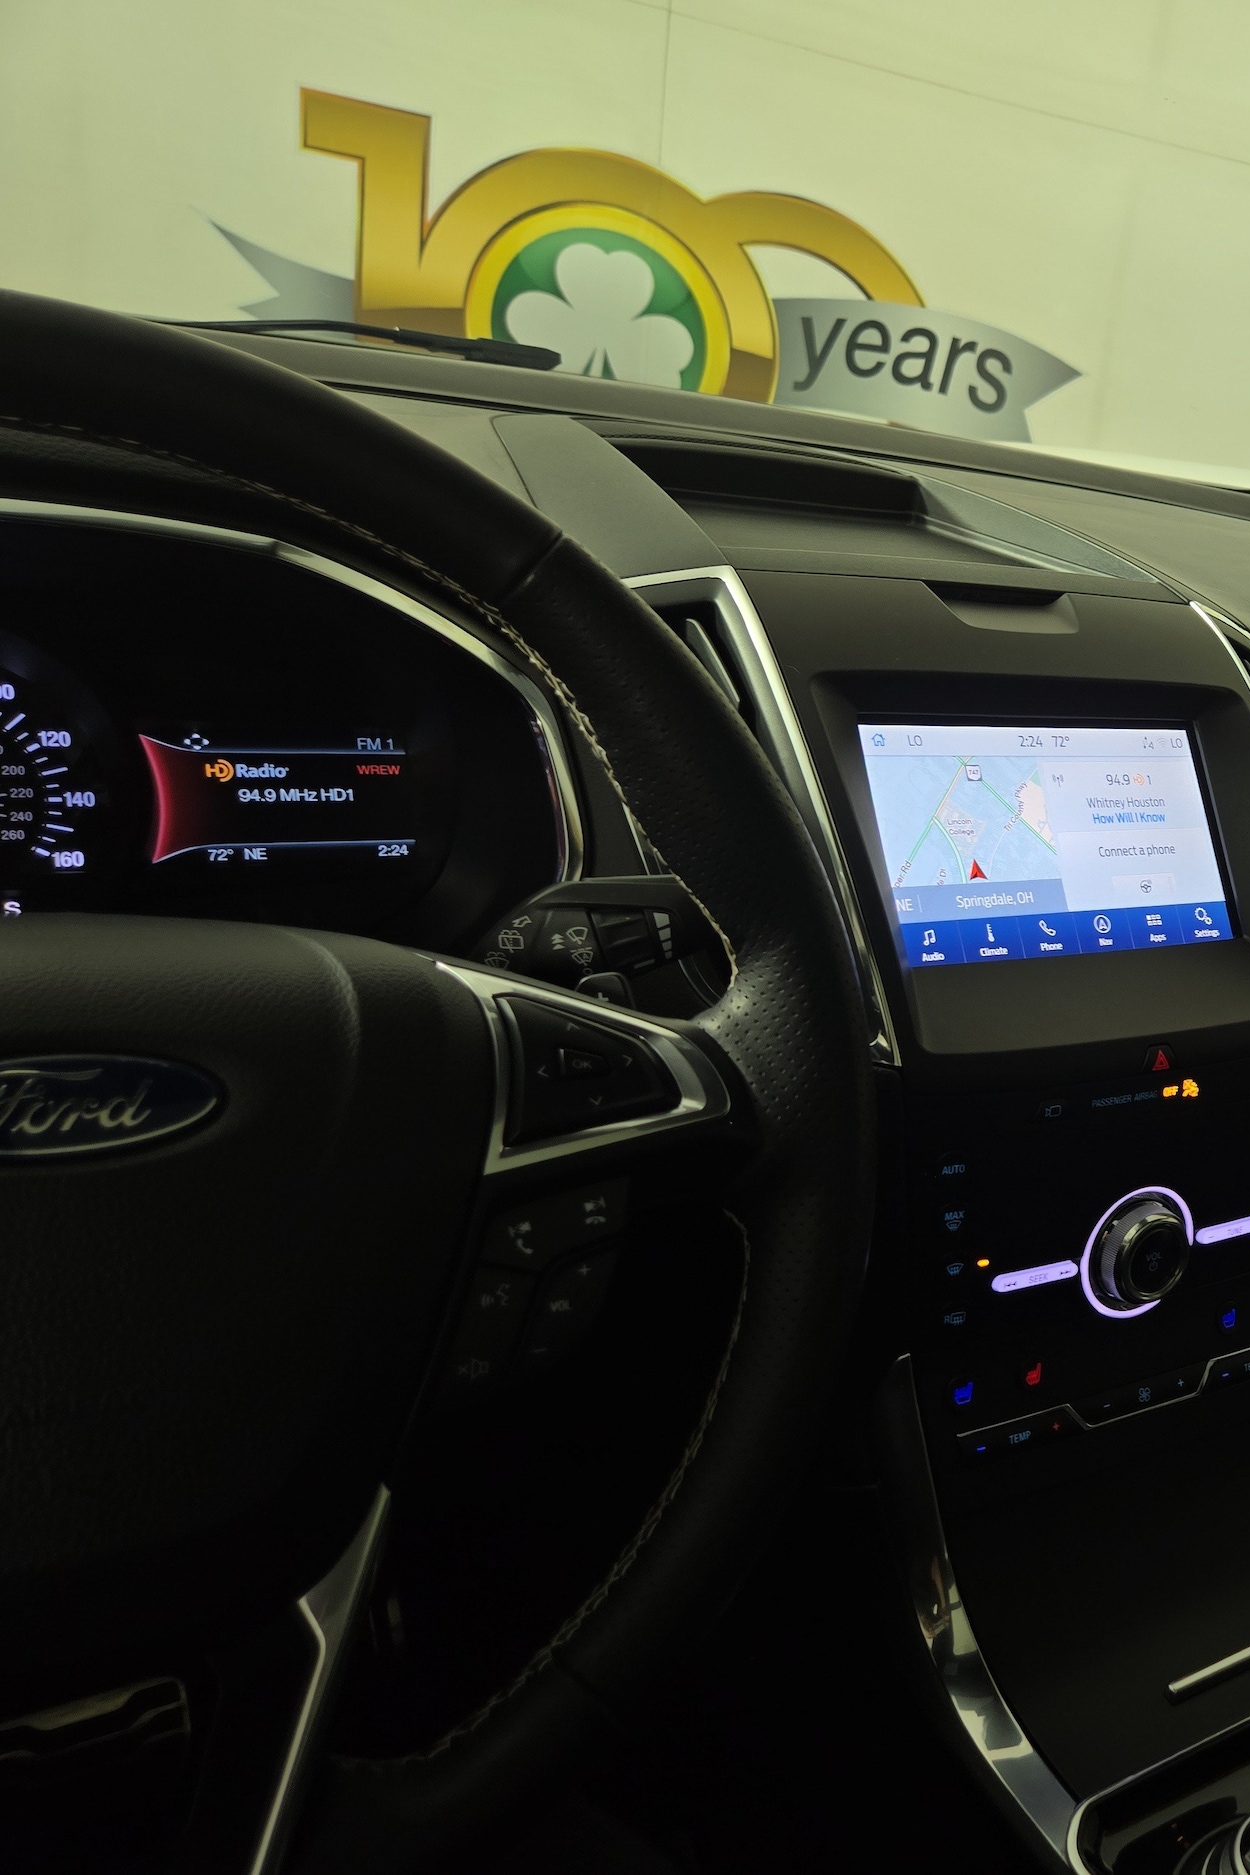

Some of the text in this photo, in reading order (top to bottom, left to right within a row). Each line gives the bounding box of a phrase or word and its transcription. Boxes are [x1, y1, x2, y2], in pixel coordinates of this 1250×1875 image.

[794, 311, 1014, 414] years
[37, 729, 72, 748] 120
[356, 737, 394, 751] FM 1
[906, 734, 923, 747] LO
[1017, 735, 1070, 748] 2:24 72°
[1170, 737, 1184, 749] LO
[1, 764, 26, 776] 200
[235, 763, 288, 779] Radio
[356, 764, 401, 776] WREW
[1106, 773, 1131, 786] 94.9
[1146, 775, 1152, 786] 1
[9, 787, 34, 799] 220
[63, 790, 96, 808] 140
[237, 788, 354, 802] 94.9 MHz HD1
[1086, 797, 1166, 810] Whitney Houston
[9, 811, 34, 822] 240
[947, 818, 973, 826] Lincoln
[1092, 813, 1114, 824] How
[1115, 812, 1135, 824] Will
[1139, 812, 1166, 823] Know
[1, 829, 26, 841] 260
[948, 828, 976, 836] College
[207, 847, 268, 862] 72° NE
[377, 844, 410, 857] 2:24
[1098, 844, 1176, 858] Connect a phone
[51, 850, 86, 869] 160
[900, 860, 912, 874] Rd
[896, 891, 1035, 912] NE Springdale, OH
[1149, 933, 1167, 943] Apps
[1194, 928, 1220, 938] Settings
[1039, 942, 1063, 951] Phone
[1098, 938, 1113, 947] Nav
[922, 952, 945, 962] Audio
[979, 946, 1009, 957] Climate
[572, 1059, 592, 1069] OK
[1091, 1094, 1133, 1108] PASSENGER
[941, 1163, 966, 1175] AUTO
[944, 1210, 965, 1220] MAX
[1028, 1273, 1049, 1284] SEEK
[1008, 1429, 1032, 1445] TEMP
